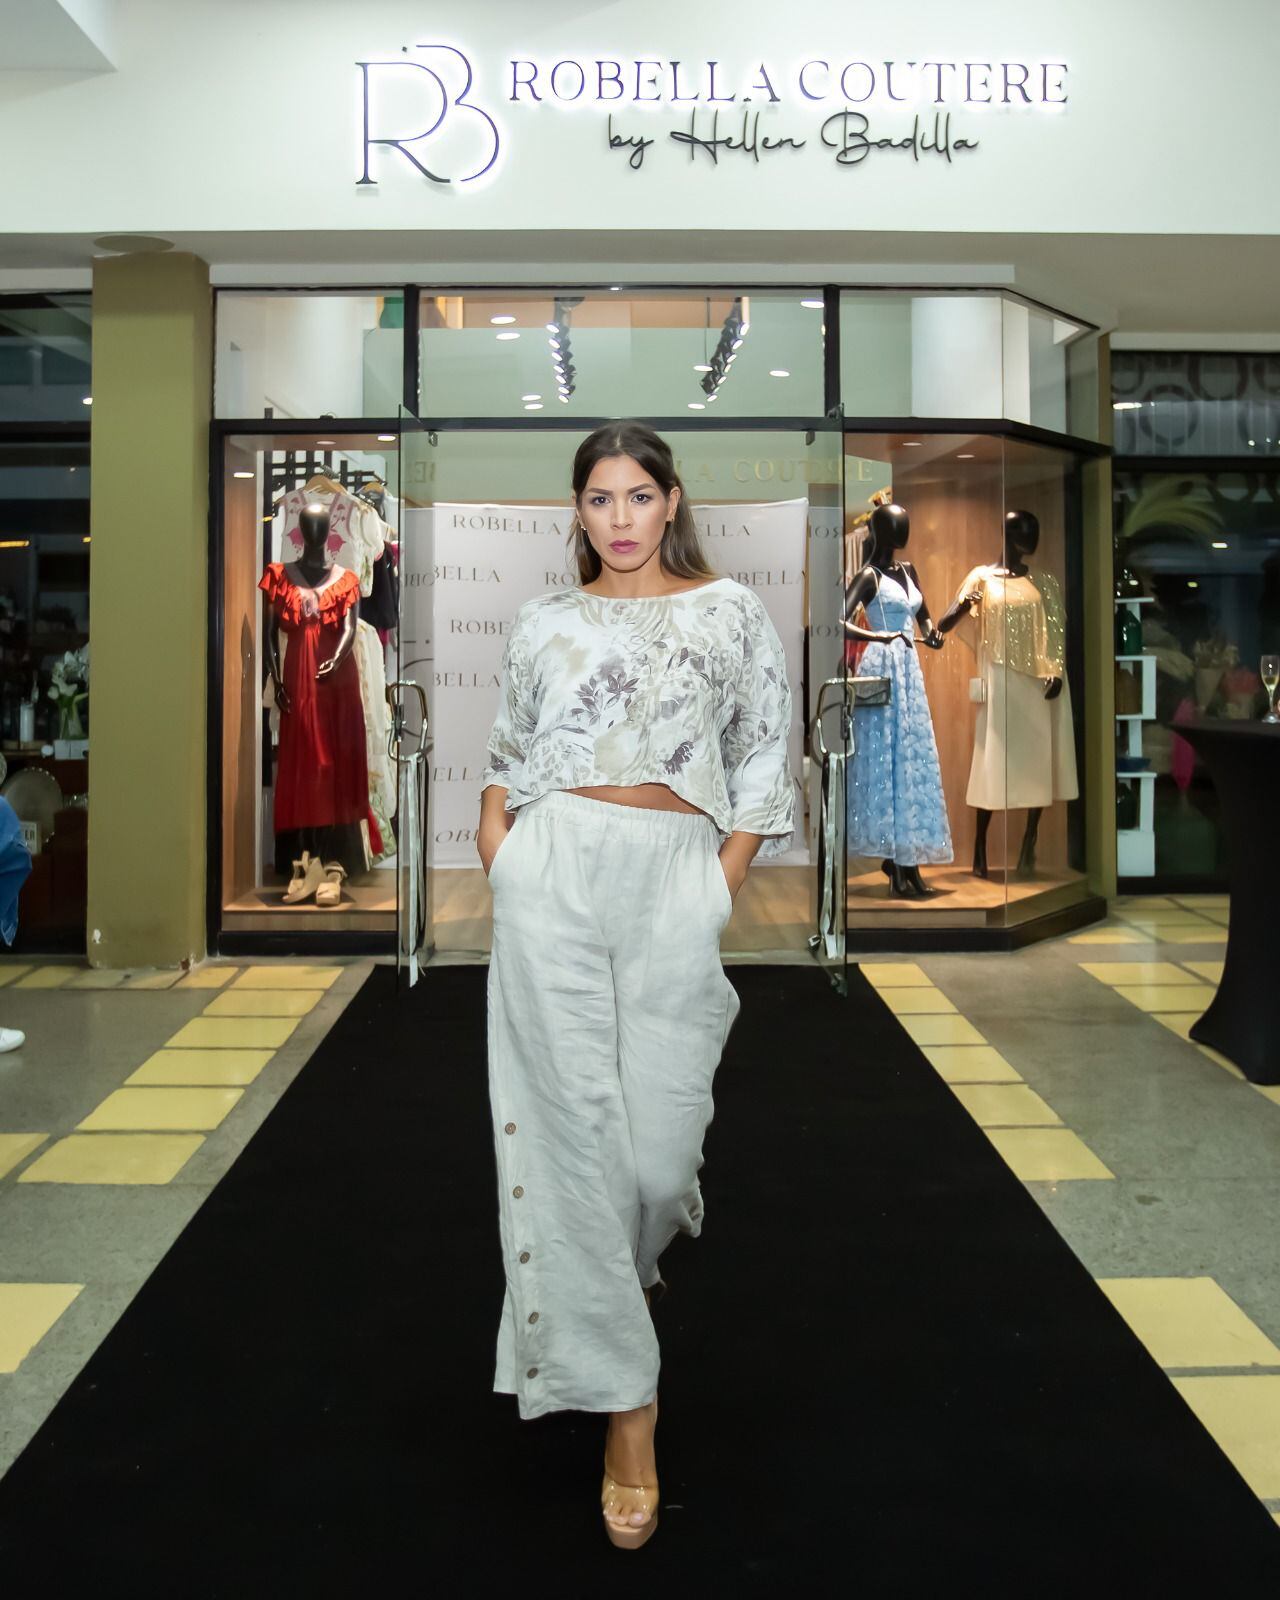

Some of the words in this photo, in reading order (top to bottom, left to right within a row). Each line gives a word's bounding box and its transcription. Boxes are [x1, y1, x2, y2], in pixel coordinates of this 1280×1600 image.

[509, 60, 781, 102] ROBELLA
[799, 60, 1069, 103] COUTERE
[608, 113, 654, 170] by
[670, 106, 806, 165] Hellen
[821, 106, 979, 165] Badilla
[453, 514, 561, 535] ROBELLA
